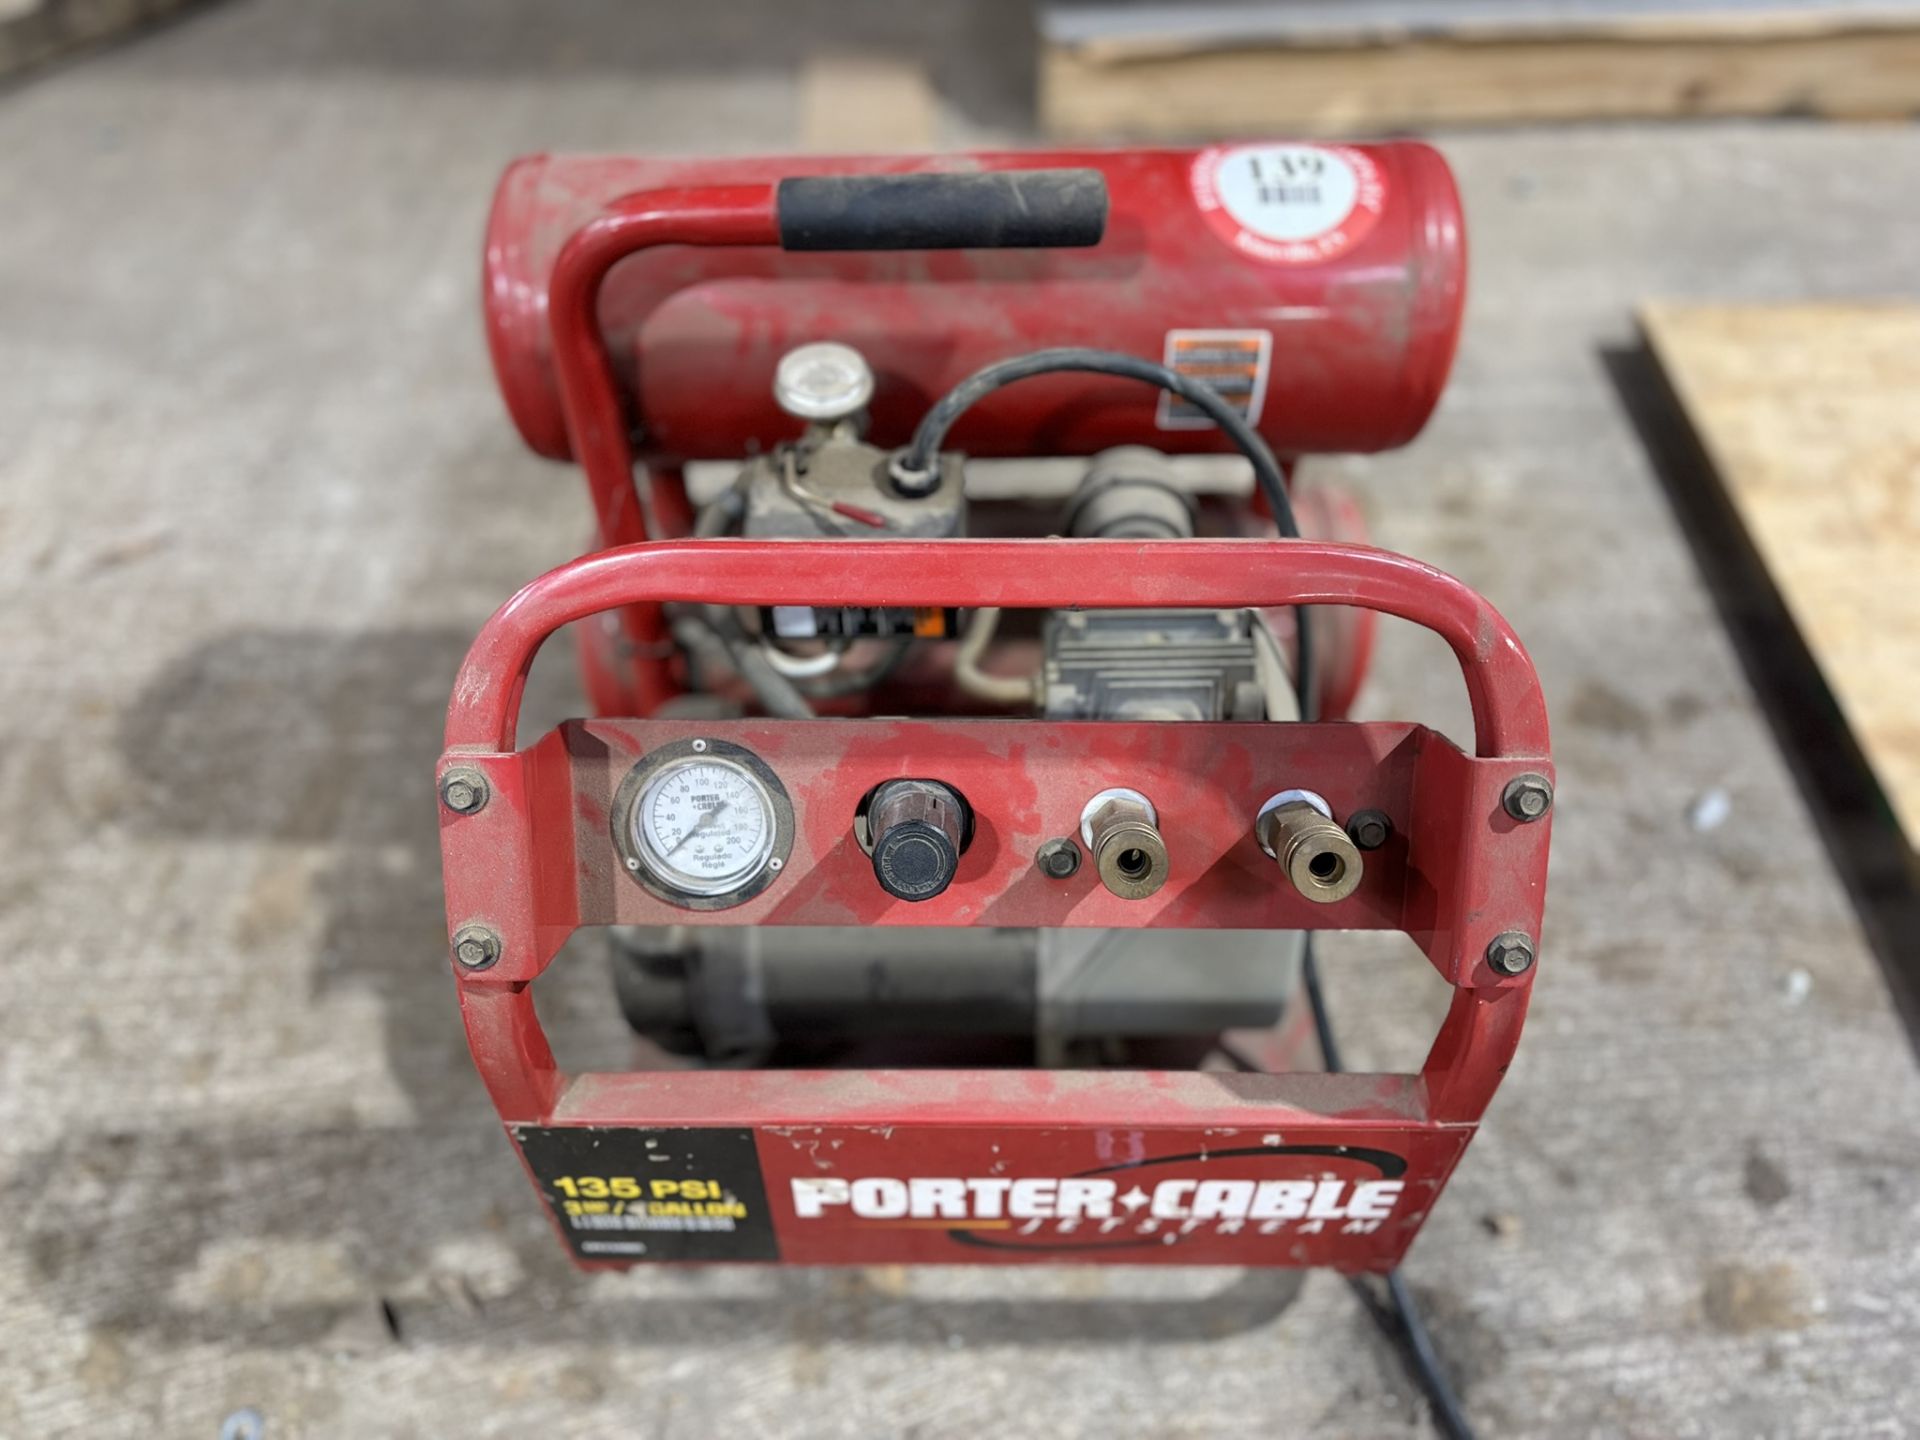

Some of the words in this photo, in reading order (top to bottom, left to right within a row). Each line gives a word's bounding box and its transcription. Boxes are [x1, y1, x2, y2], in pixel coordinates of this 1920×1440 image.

[695, 778, 710, 786] 100
[714, 781, 729, 789] 120
[680, 785, 690, 793] 80
[670, 796, 681, 804] 60
[666, 813, 676, 821] 40
[671, 828, 682, 836] 20
[726, 837, 741, 845] 200
[553, 1175, 642, 1199] 135
[649, 1179, 721, 1200] PSI
[789, 1177, 1116, 1220] PORTER
[1151, 1178, 1405, 1220] CABLE
[647, 1201, 748, 1218] GALLON
